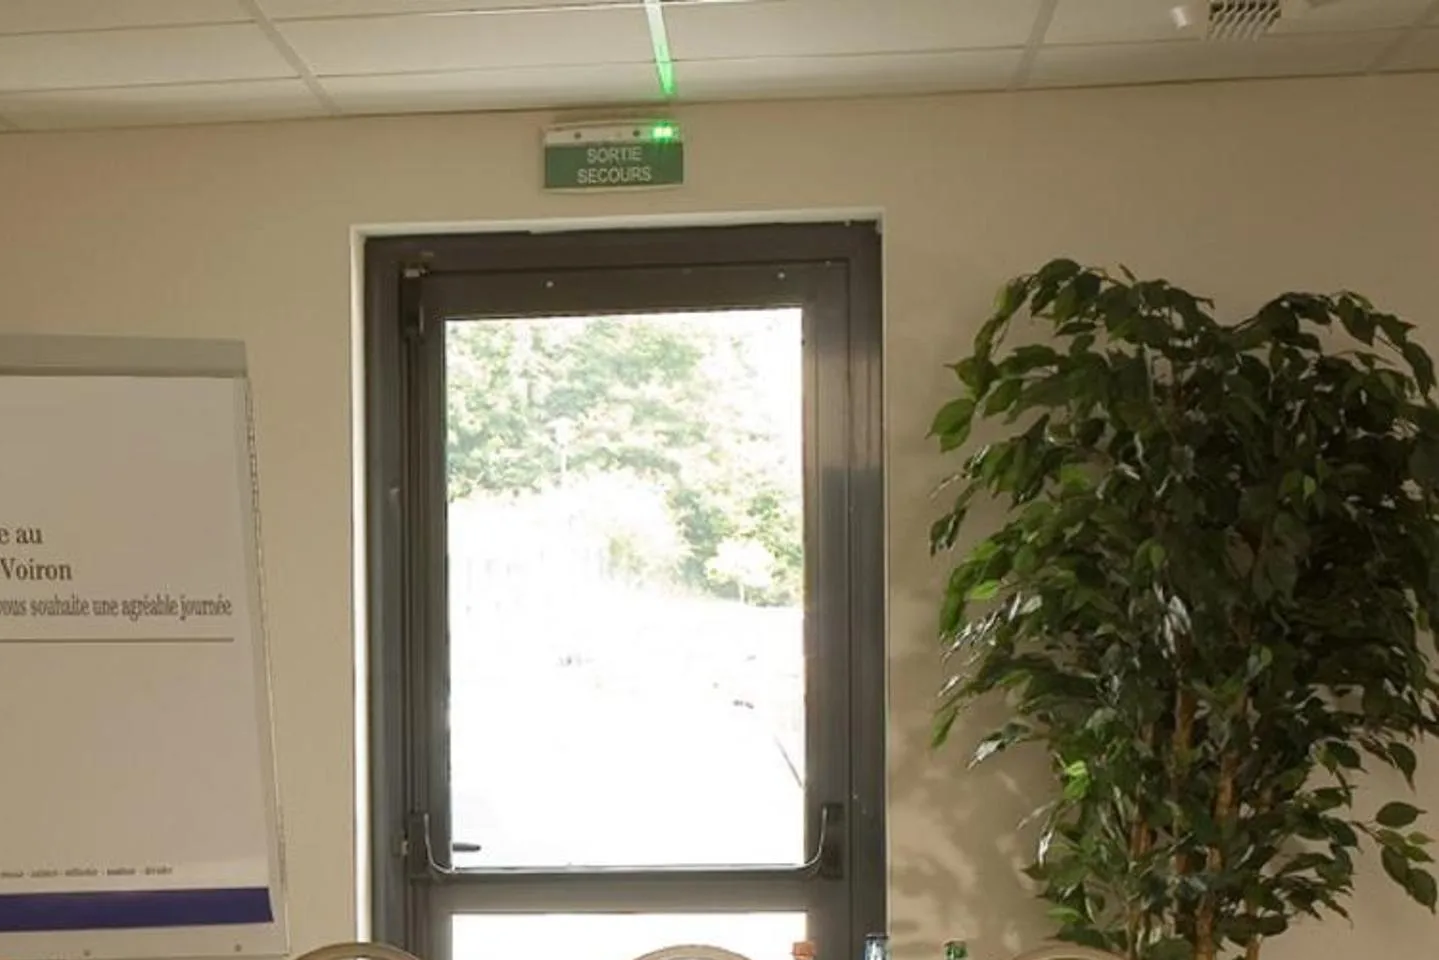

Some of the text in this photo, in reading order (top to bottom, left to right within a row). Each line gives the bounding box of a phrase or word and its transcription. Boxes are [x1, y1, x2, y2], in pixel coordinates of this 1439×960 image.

[587, 147, 642, 164] SORTIE
[577, 166, 652, 184] SECOURS
[16, 527, 43, 545] au
[0, 557, 72, 581] Voiron
[30, 594, 90, 616] souhaite
[92, 600, 119, 616] une
[121, 594, 179, 622] agréable
[179, 594, 233, 621] journée
